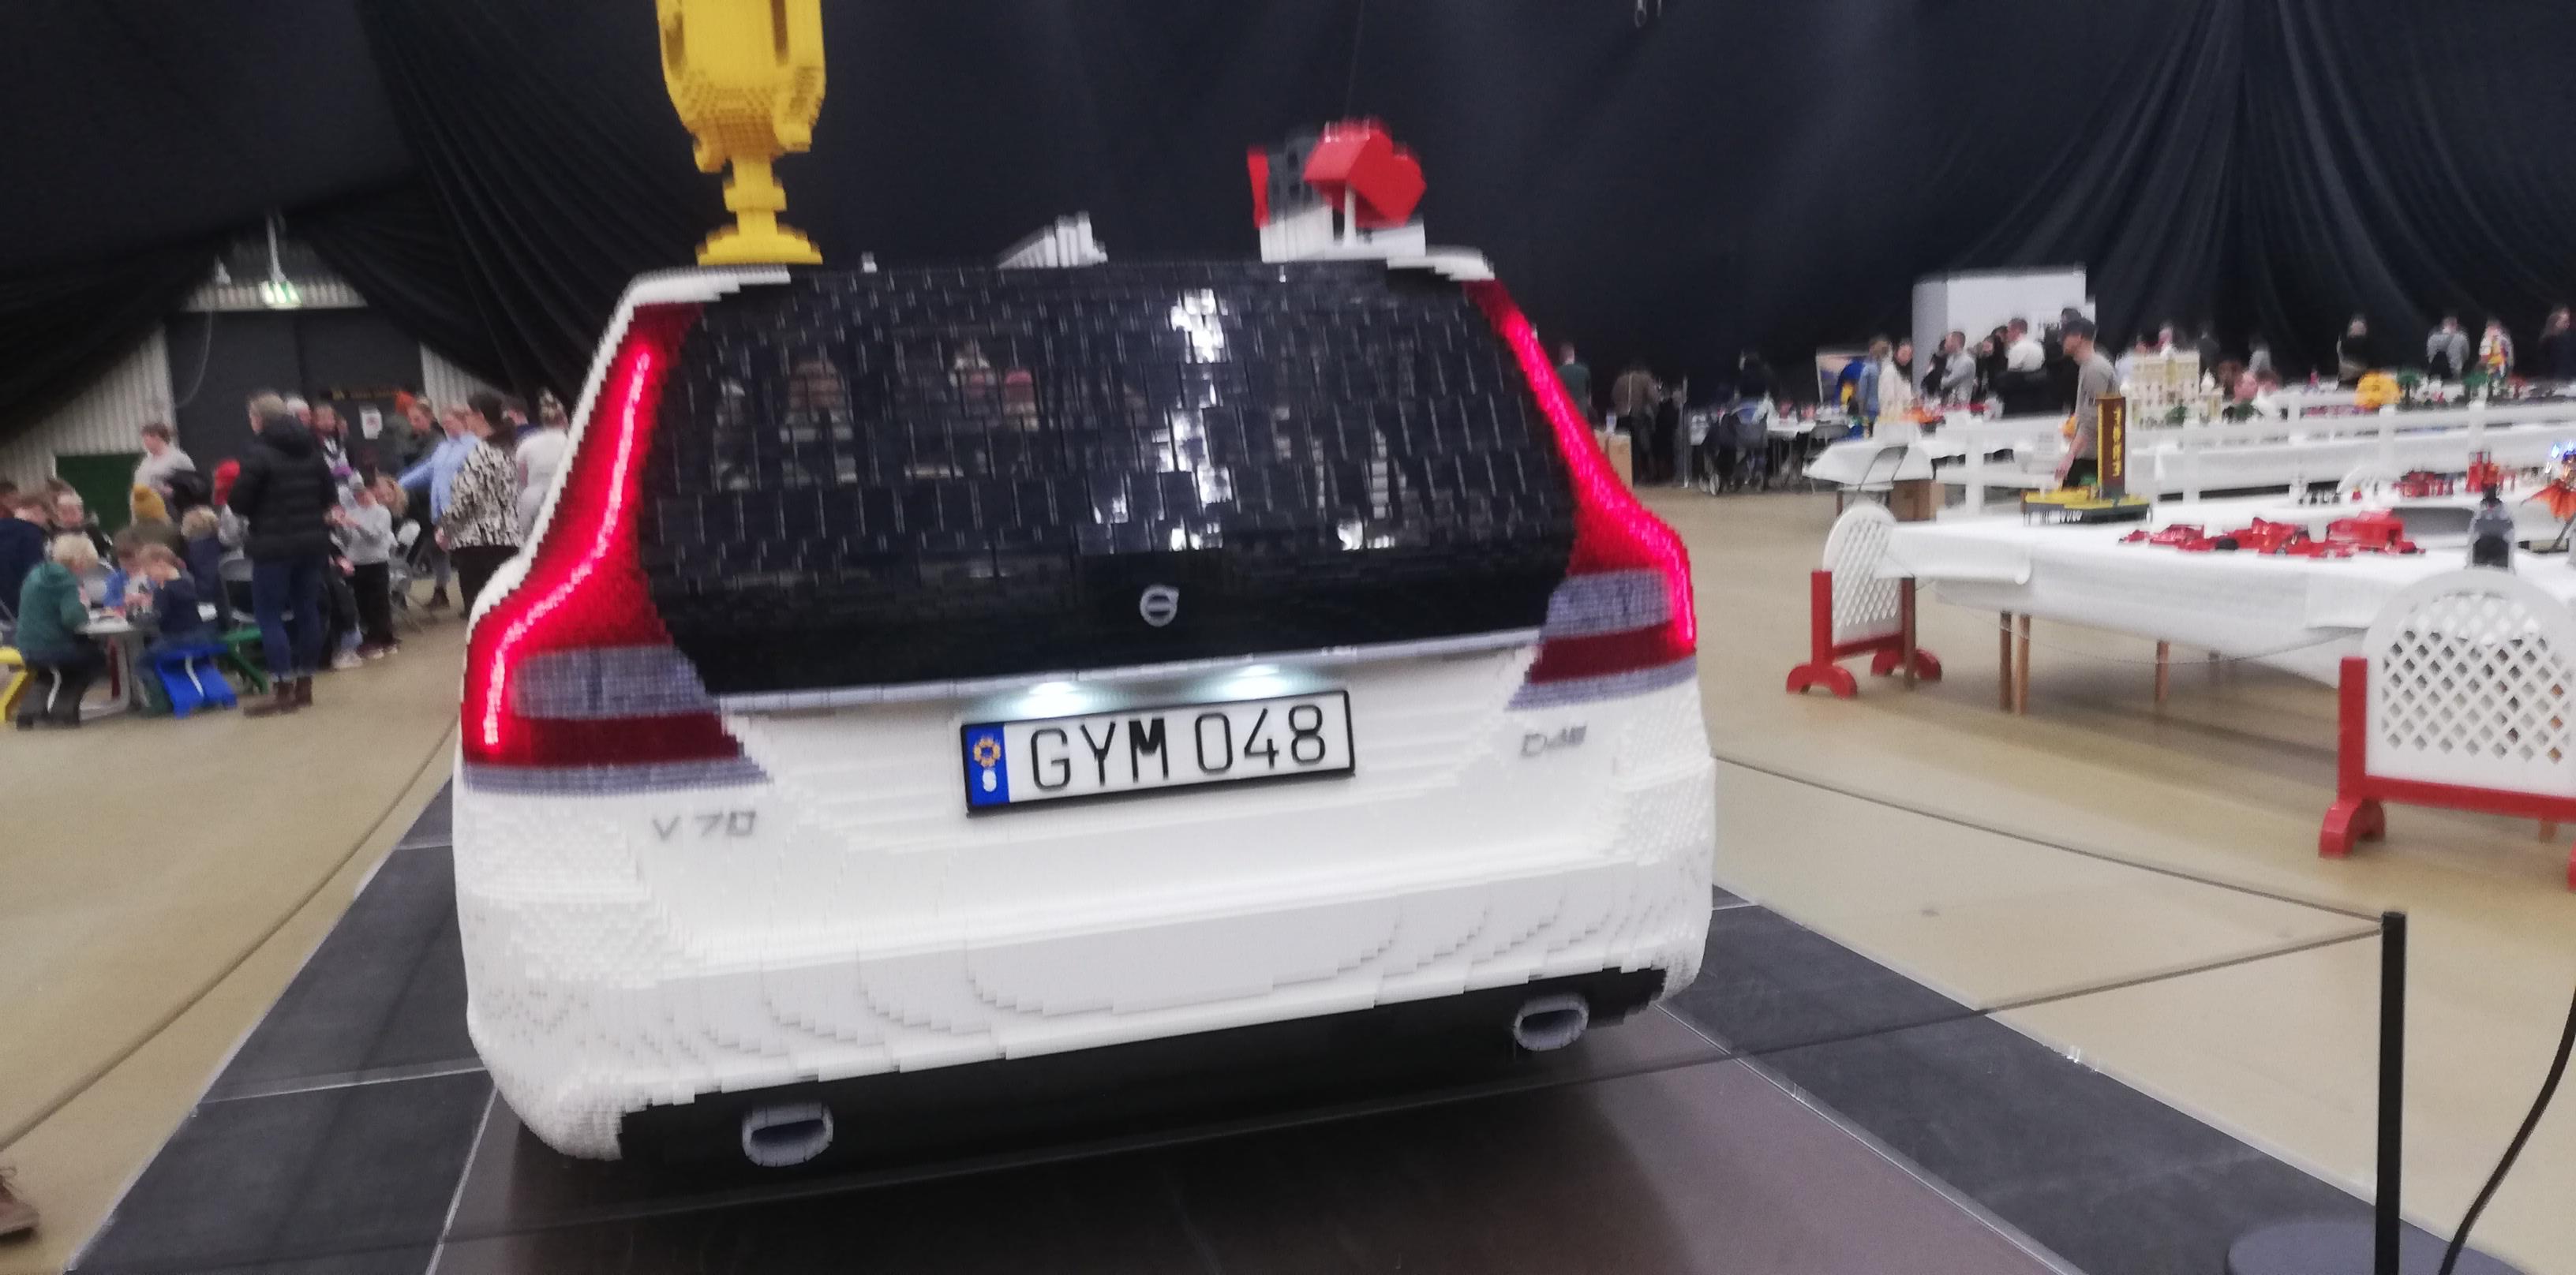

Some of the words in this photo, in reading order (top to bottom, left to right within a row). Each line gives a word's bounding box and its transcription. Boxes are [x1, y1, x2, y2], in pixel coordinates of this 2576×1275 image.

[1030, 717, 1170, 791] GYM
[1195, 704, 1327, 775] 048
[651, 814, 681, 842] V
[694, 810, 757, 838] 70
